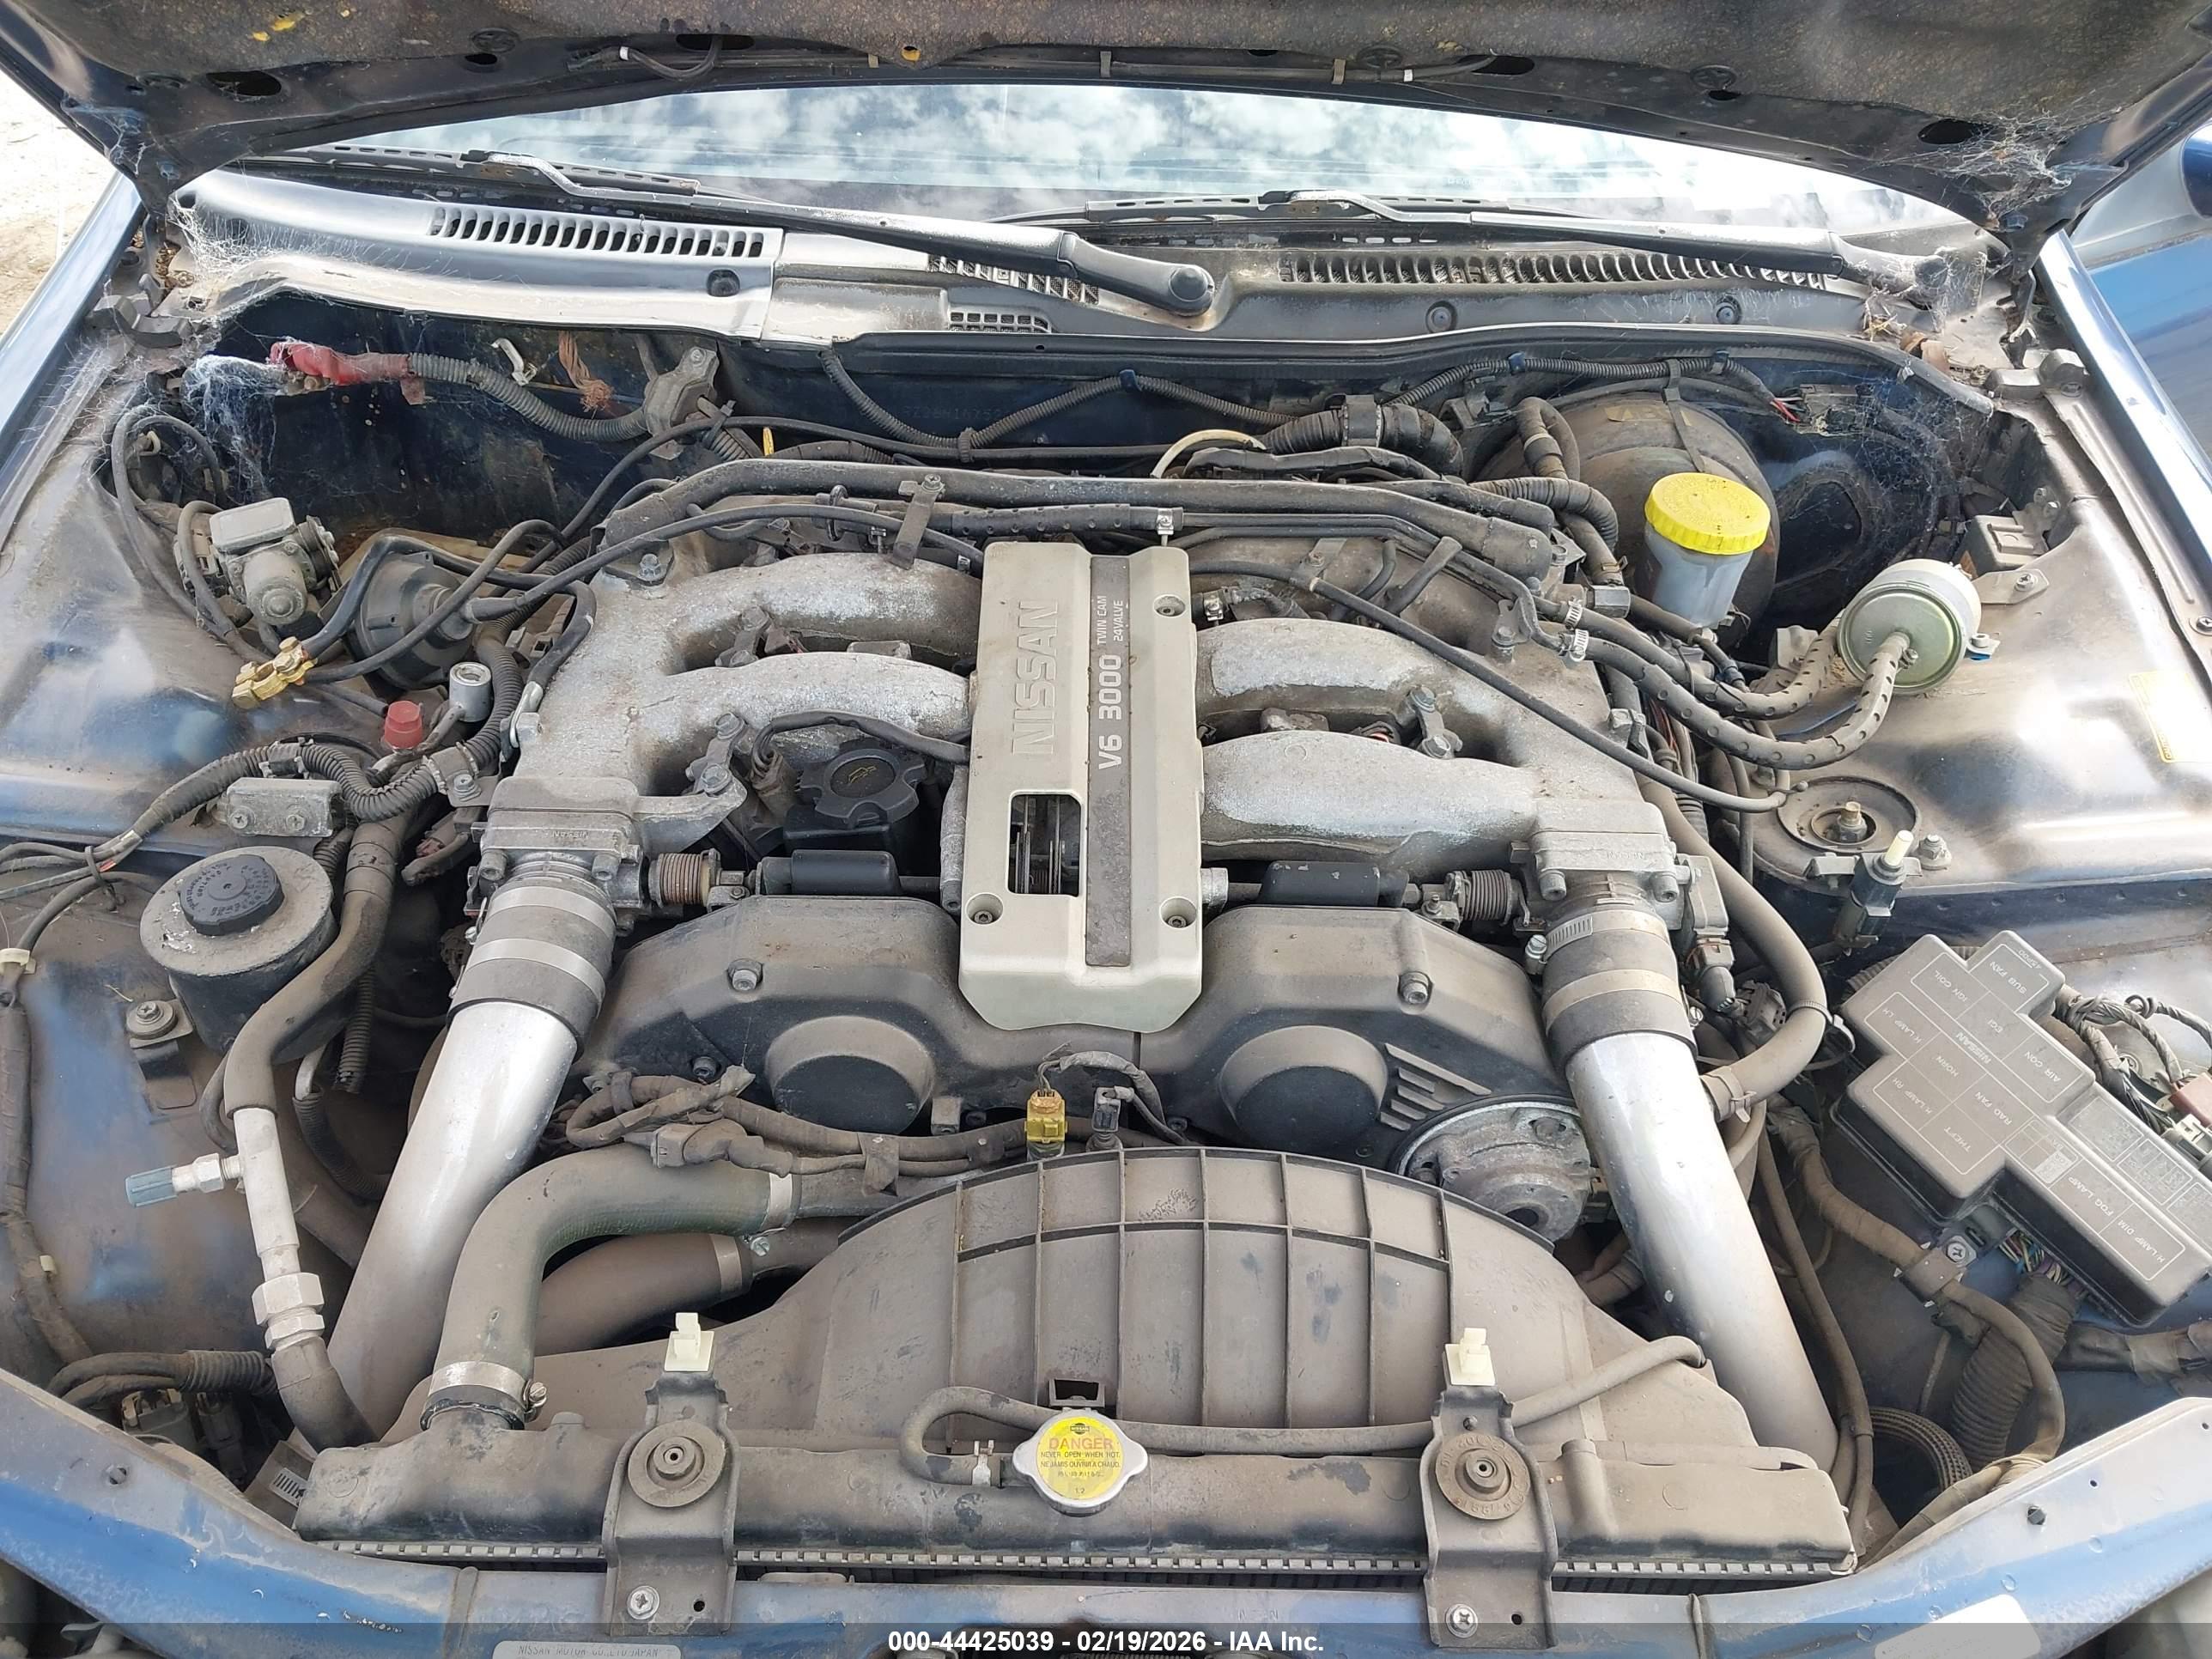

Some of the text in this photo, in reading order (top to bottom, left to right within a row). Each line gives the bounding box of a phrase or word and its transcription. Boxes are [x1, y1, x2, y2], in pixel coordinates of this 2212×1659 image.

[1097, 595, 1107, 645] TWIN CAM
[1113, 600, 1124, 641] 24VALVE
[1012, 601, 1058, 756] NISSAN
[1098, 654, 1122, 769] V6 3000
[1934, 969, 1968, 1002] IGN COIL
[1990, 961, 2027, 994] SUB FAN
[1987, 1018, 2003, 1034] EGI
[1955, 1031, 1992, 1064] NISSAN
[1935, 1055, 1960, 1078] HORN
[2024, 1050, 2062, 1082] AIR CON
[1892, 1078, 1905, 1089] RH
[1975, 1091, 2013, 1126] RAD FAN
[1943, 1126, 1972, 1152] THEFT
[2068, 1176, 2114, 1217] FOG LAMP
[2117, 1219, 2135, 1236] DIM
[1048, 1437, 1114, 1449] DANGER
[518, 1644, 550, 1656] NISSAN
